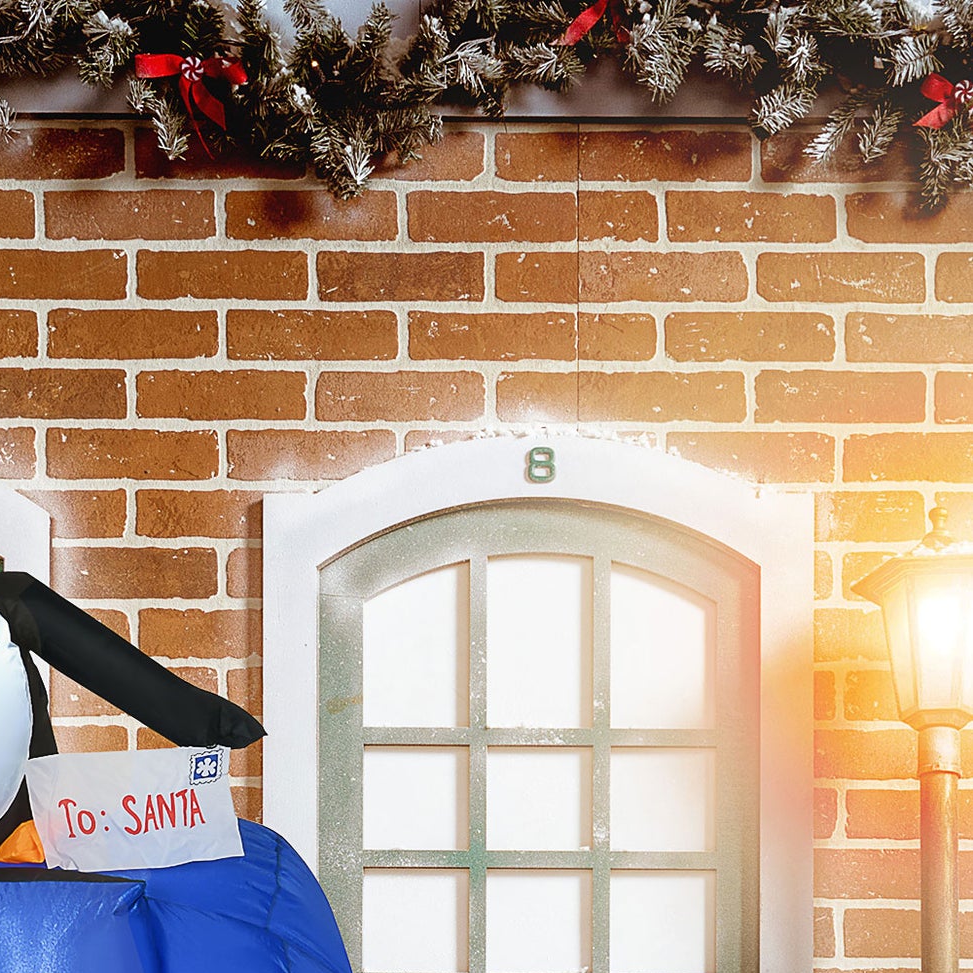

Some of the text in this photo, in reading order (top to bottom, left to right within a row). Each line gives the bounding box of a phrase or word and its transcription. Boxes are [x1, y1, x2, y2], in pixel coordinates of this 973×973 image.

[527, 446, 556, 483] 8
[58, 788, 206, 838] To: SANTA
